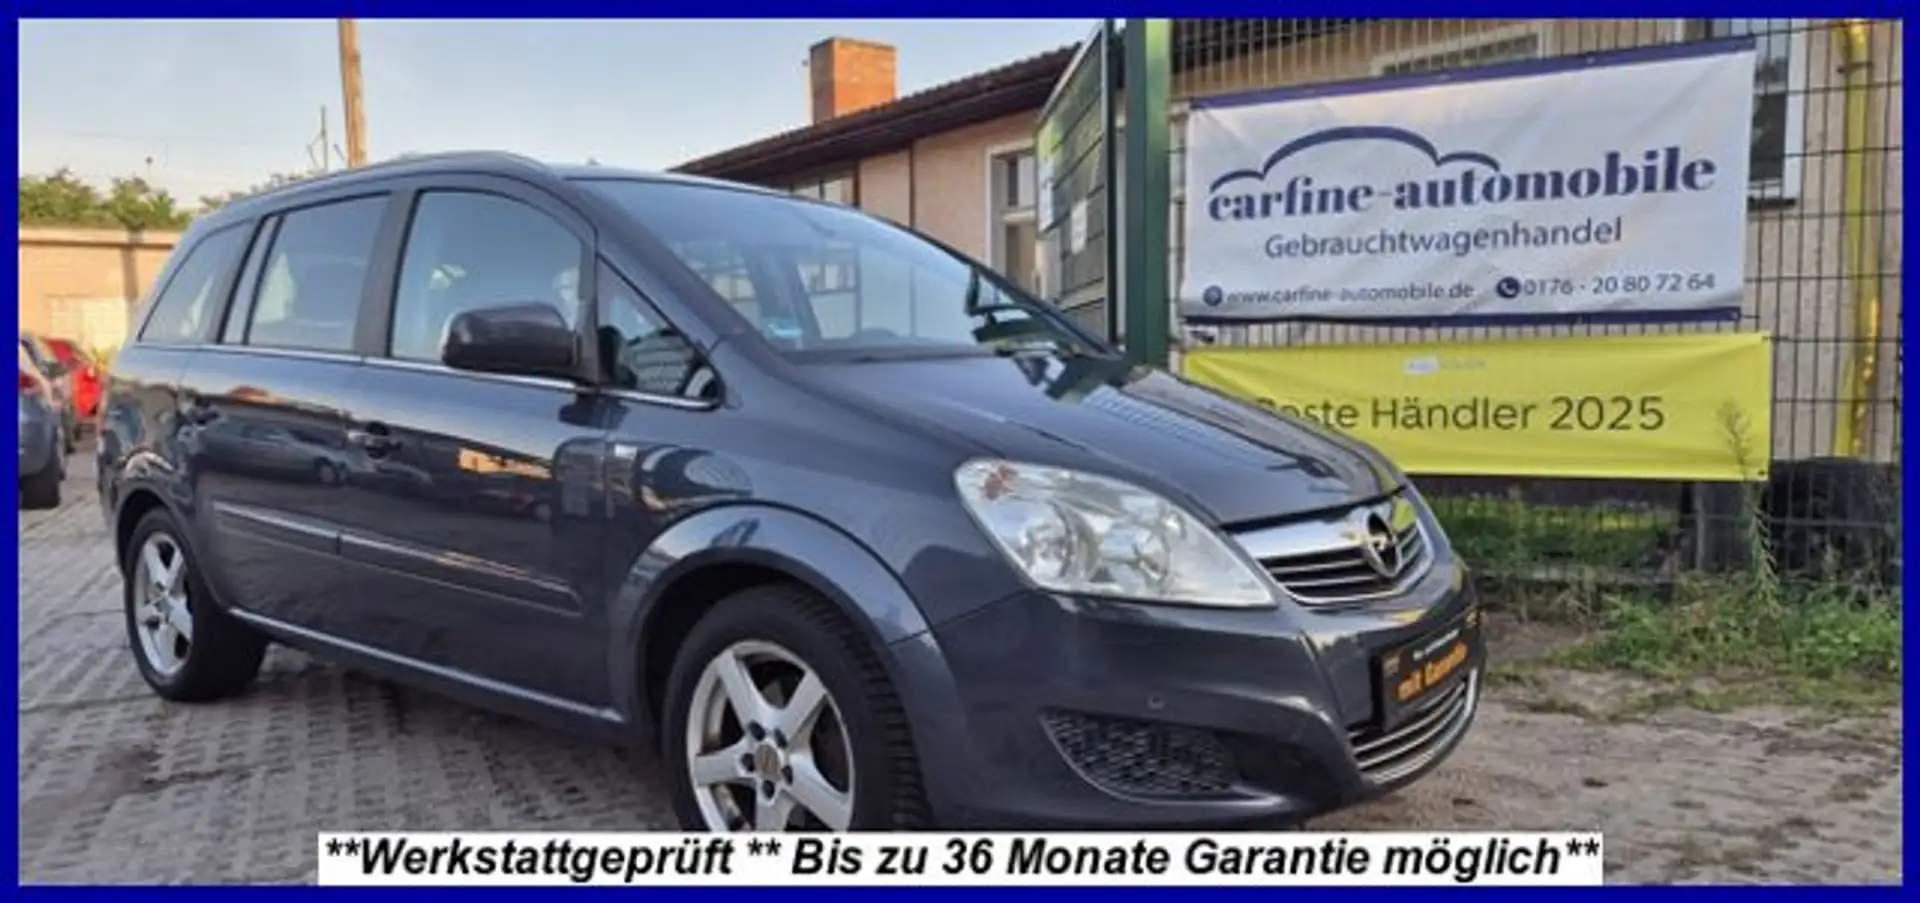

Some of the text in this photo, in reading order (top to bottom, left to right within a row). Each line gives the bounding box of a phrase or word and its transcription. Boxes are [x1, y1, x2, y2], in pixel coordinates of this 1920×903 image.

[1208, 146, 1717, 222] carfine-automobile
[1264, 216, 1622, 259] Gebrauchtwagenhandel
[1523, 277, 1574, 296] 0176
[1592, 276, 1619, 294] 20
[1623, 275, 1650, 293] 80
[1655, 273, 1683, 292] 72
[1687, 273, 1716, 290] 64
[1371, 396, 1537, 431] Händler
[1549, 396, 1665, 431] 2025
